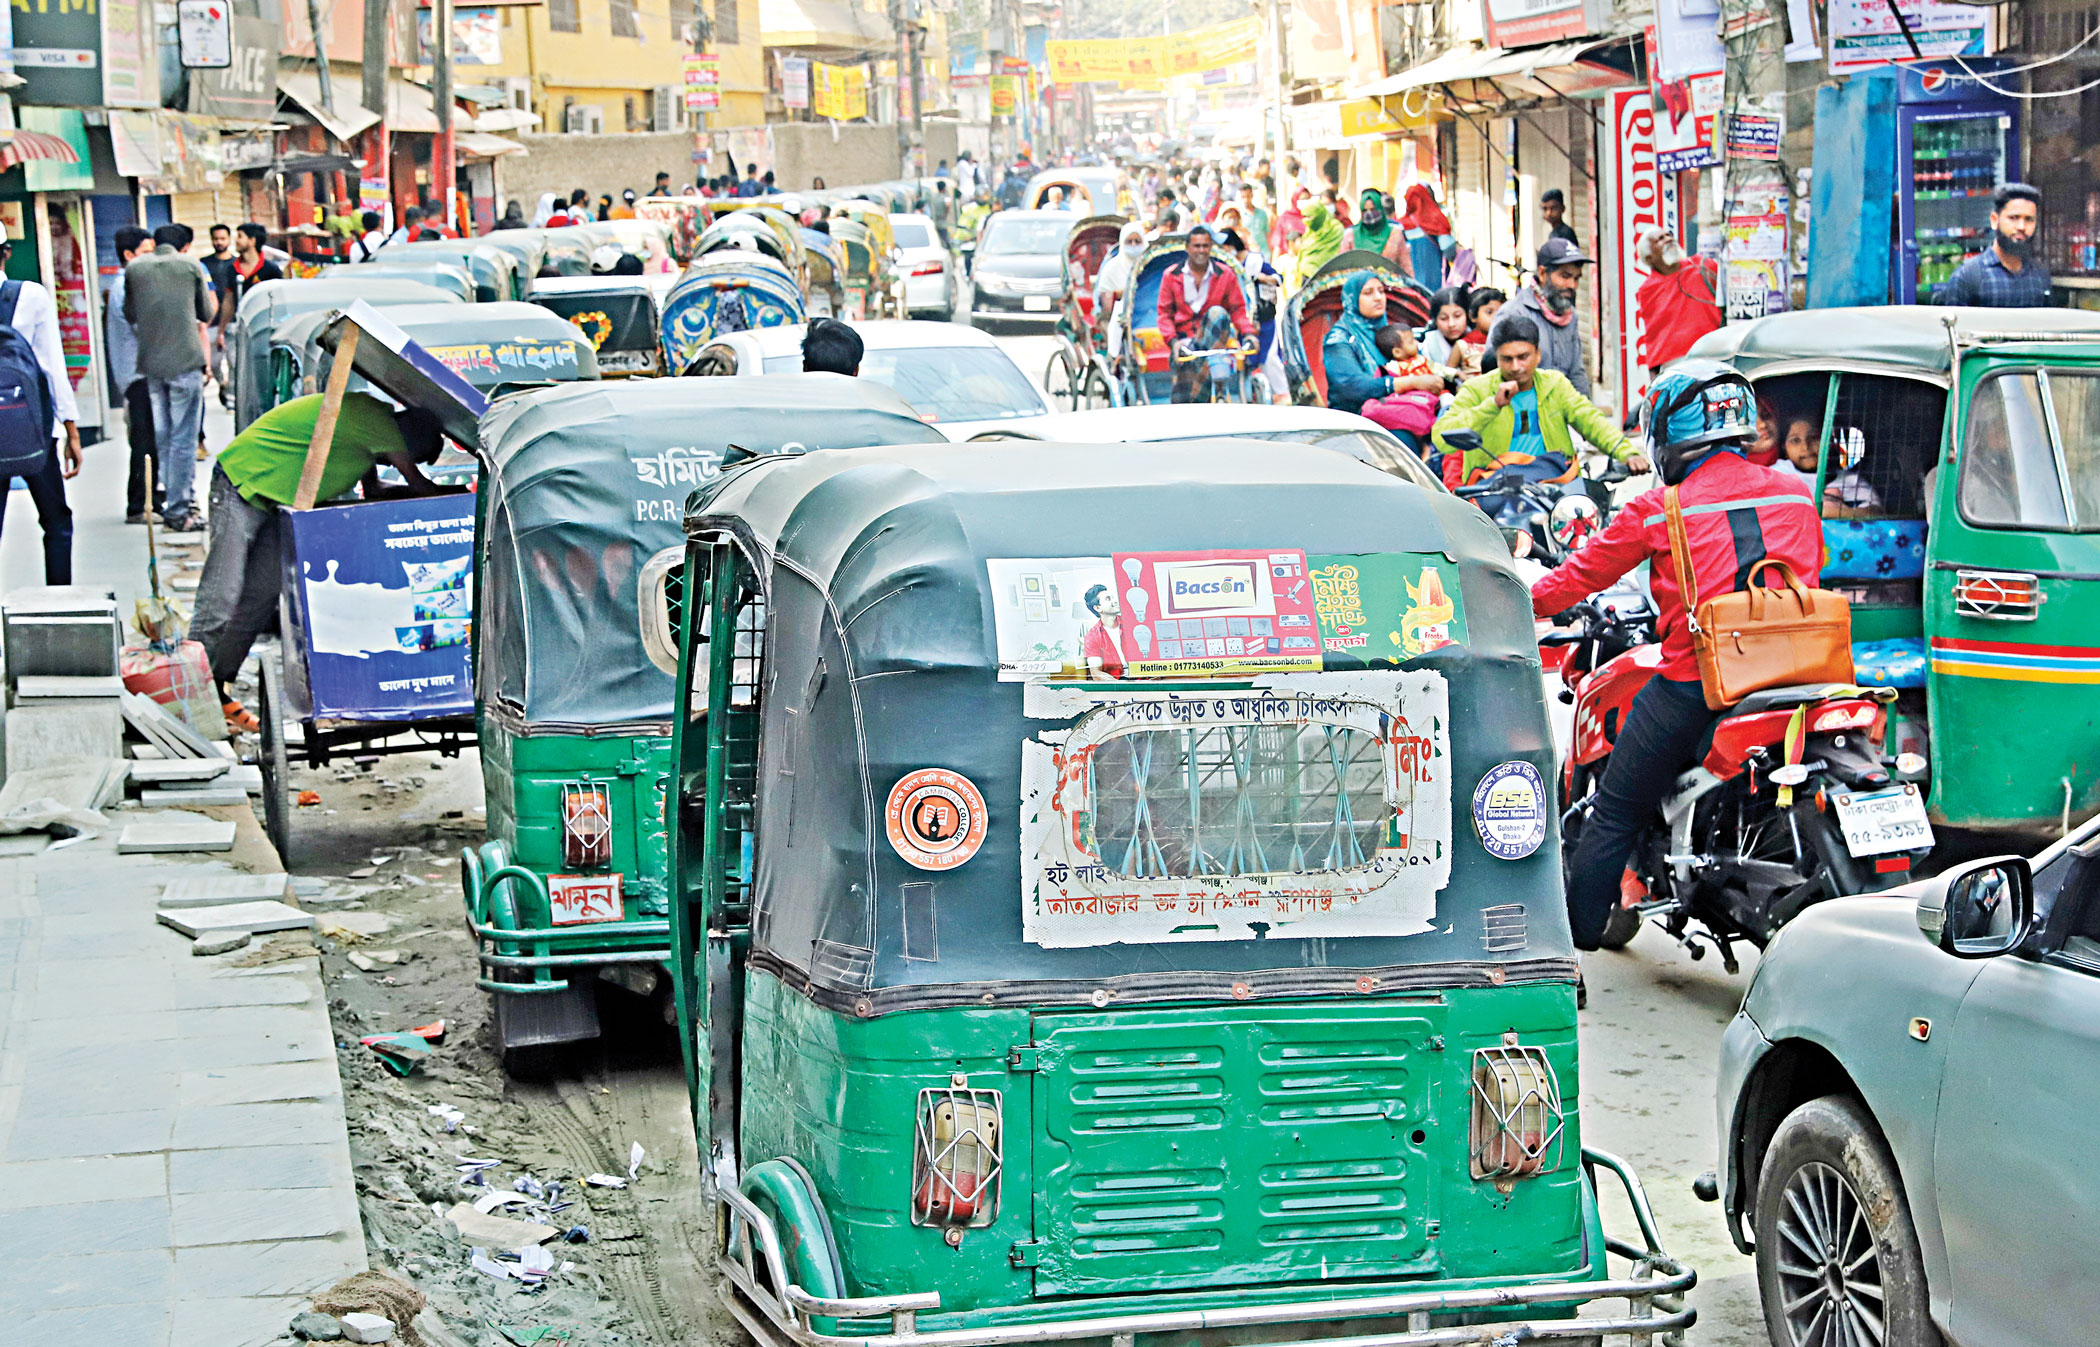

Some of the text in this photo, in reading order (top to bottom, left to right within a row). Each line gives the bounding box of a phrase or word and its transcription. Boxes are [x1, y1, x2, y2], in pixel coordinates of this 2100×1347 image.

[1175, 577, 1245, 596] Bacson
[1140, 662, 1168, 672] Hotline
[1173, 661, 1224, 671] 01773140533
[1168, 693, 1207, 722] উন্নত
[1212, 700, 1225, 718] ও
[1231, 690, 1290, 725] আধুনিক
[1489, 789, 1533, 809] BSB
[918, 788, 967, 842] CAMBRIAN COLLEGE
[1487, 810, 1534, 818] Global Network
[1843, 804, 1867, 816] ঢাকা
[1497, 824, 1526, 832] Gulshan-2
[1503, 844, 1523, 854] 557
[918, 855, 934, 865] 557
[1045, 861, 1070, 887] হট
